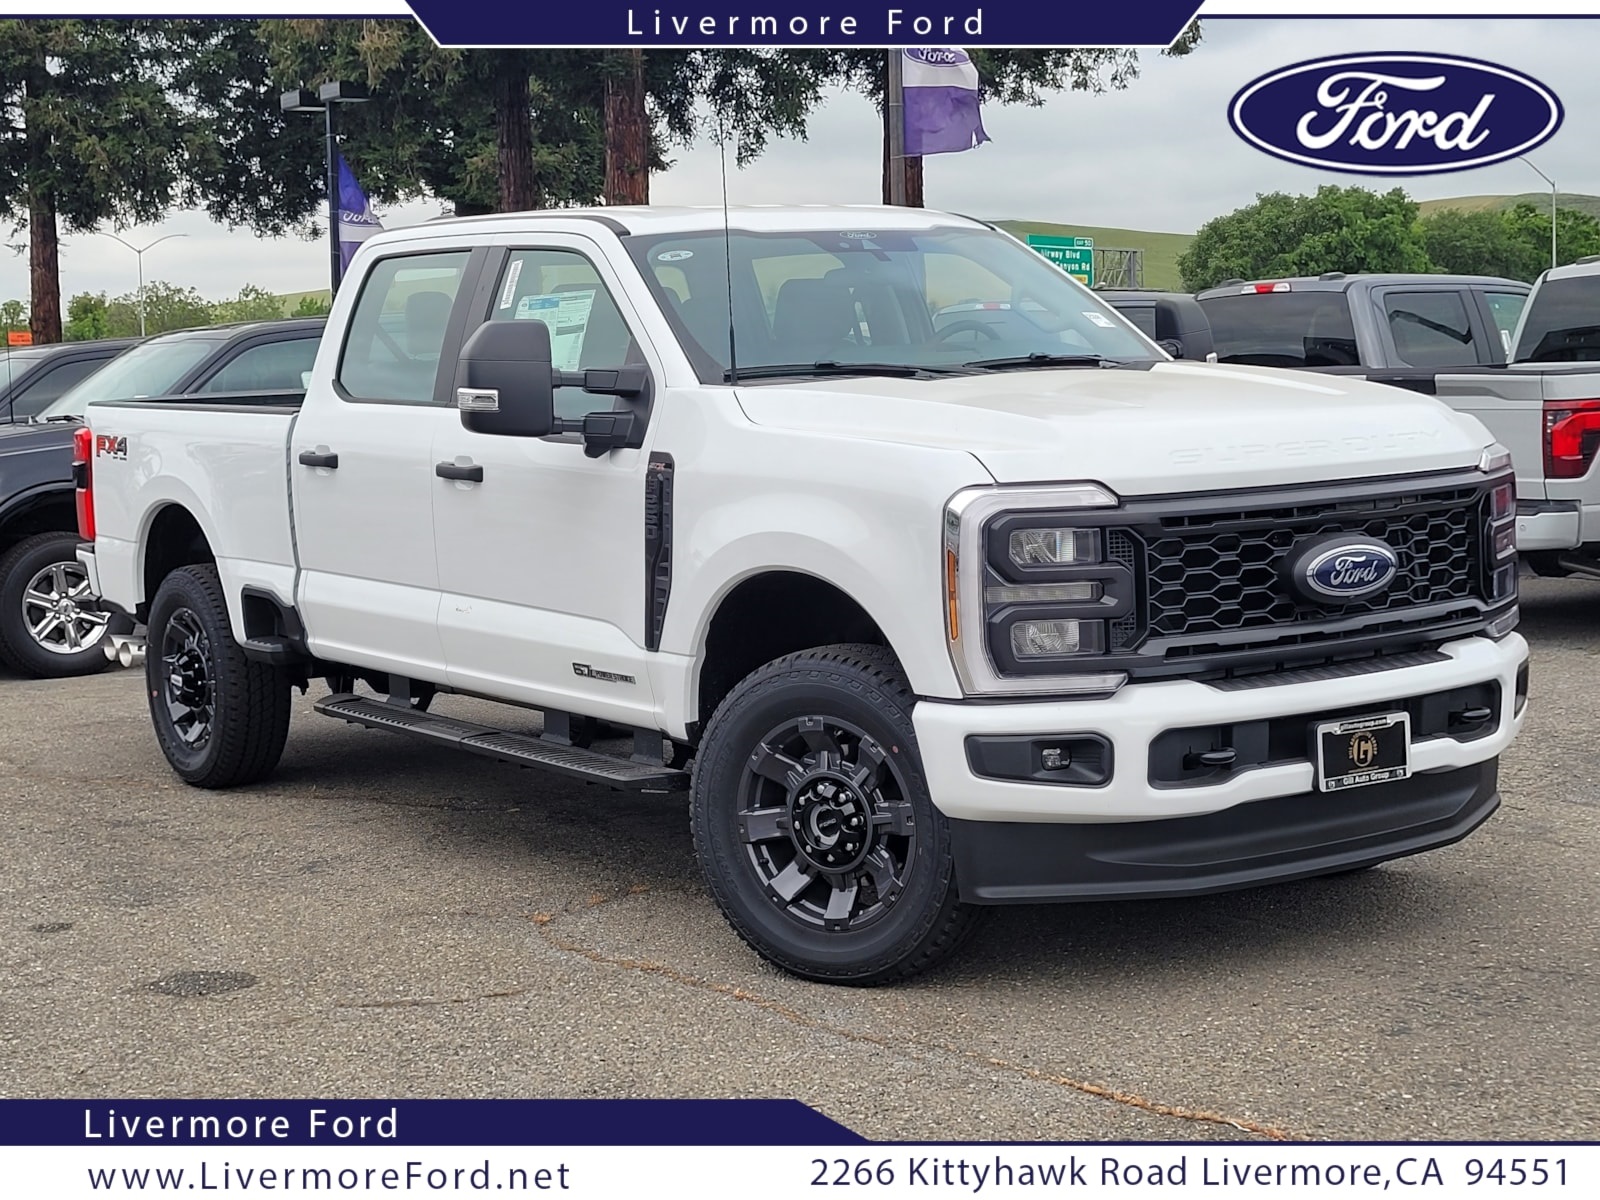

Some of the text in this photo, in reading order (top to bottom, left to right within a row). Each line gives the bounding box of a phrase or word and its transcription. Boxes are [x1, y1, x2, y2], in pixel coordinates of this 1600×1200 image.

[1065, 250, 1081, 259] Blvd
[1081, 262, 1091, 271] Rd
[96, 434, 128, 457] FX4
[1330, 555, 1379, 586] Ford
